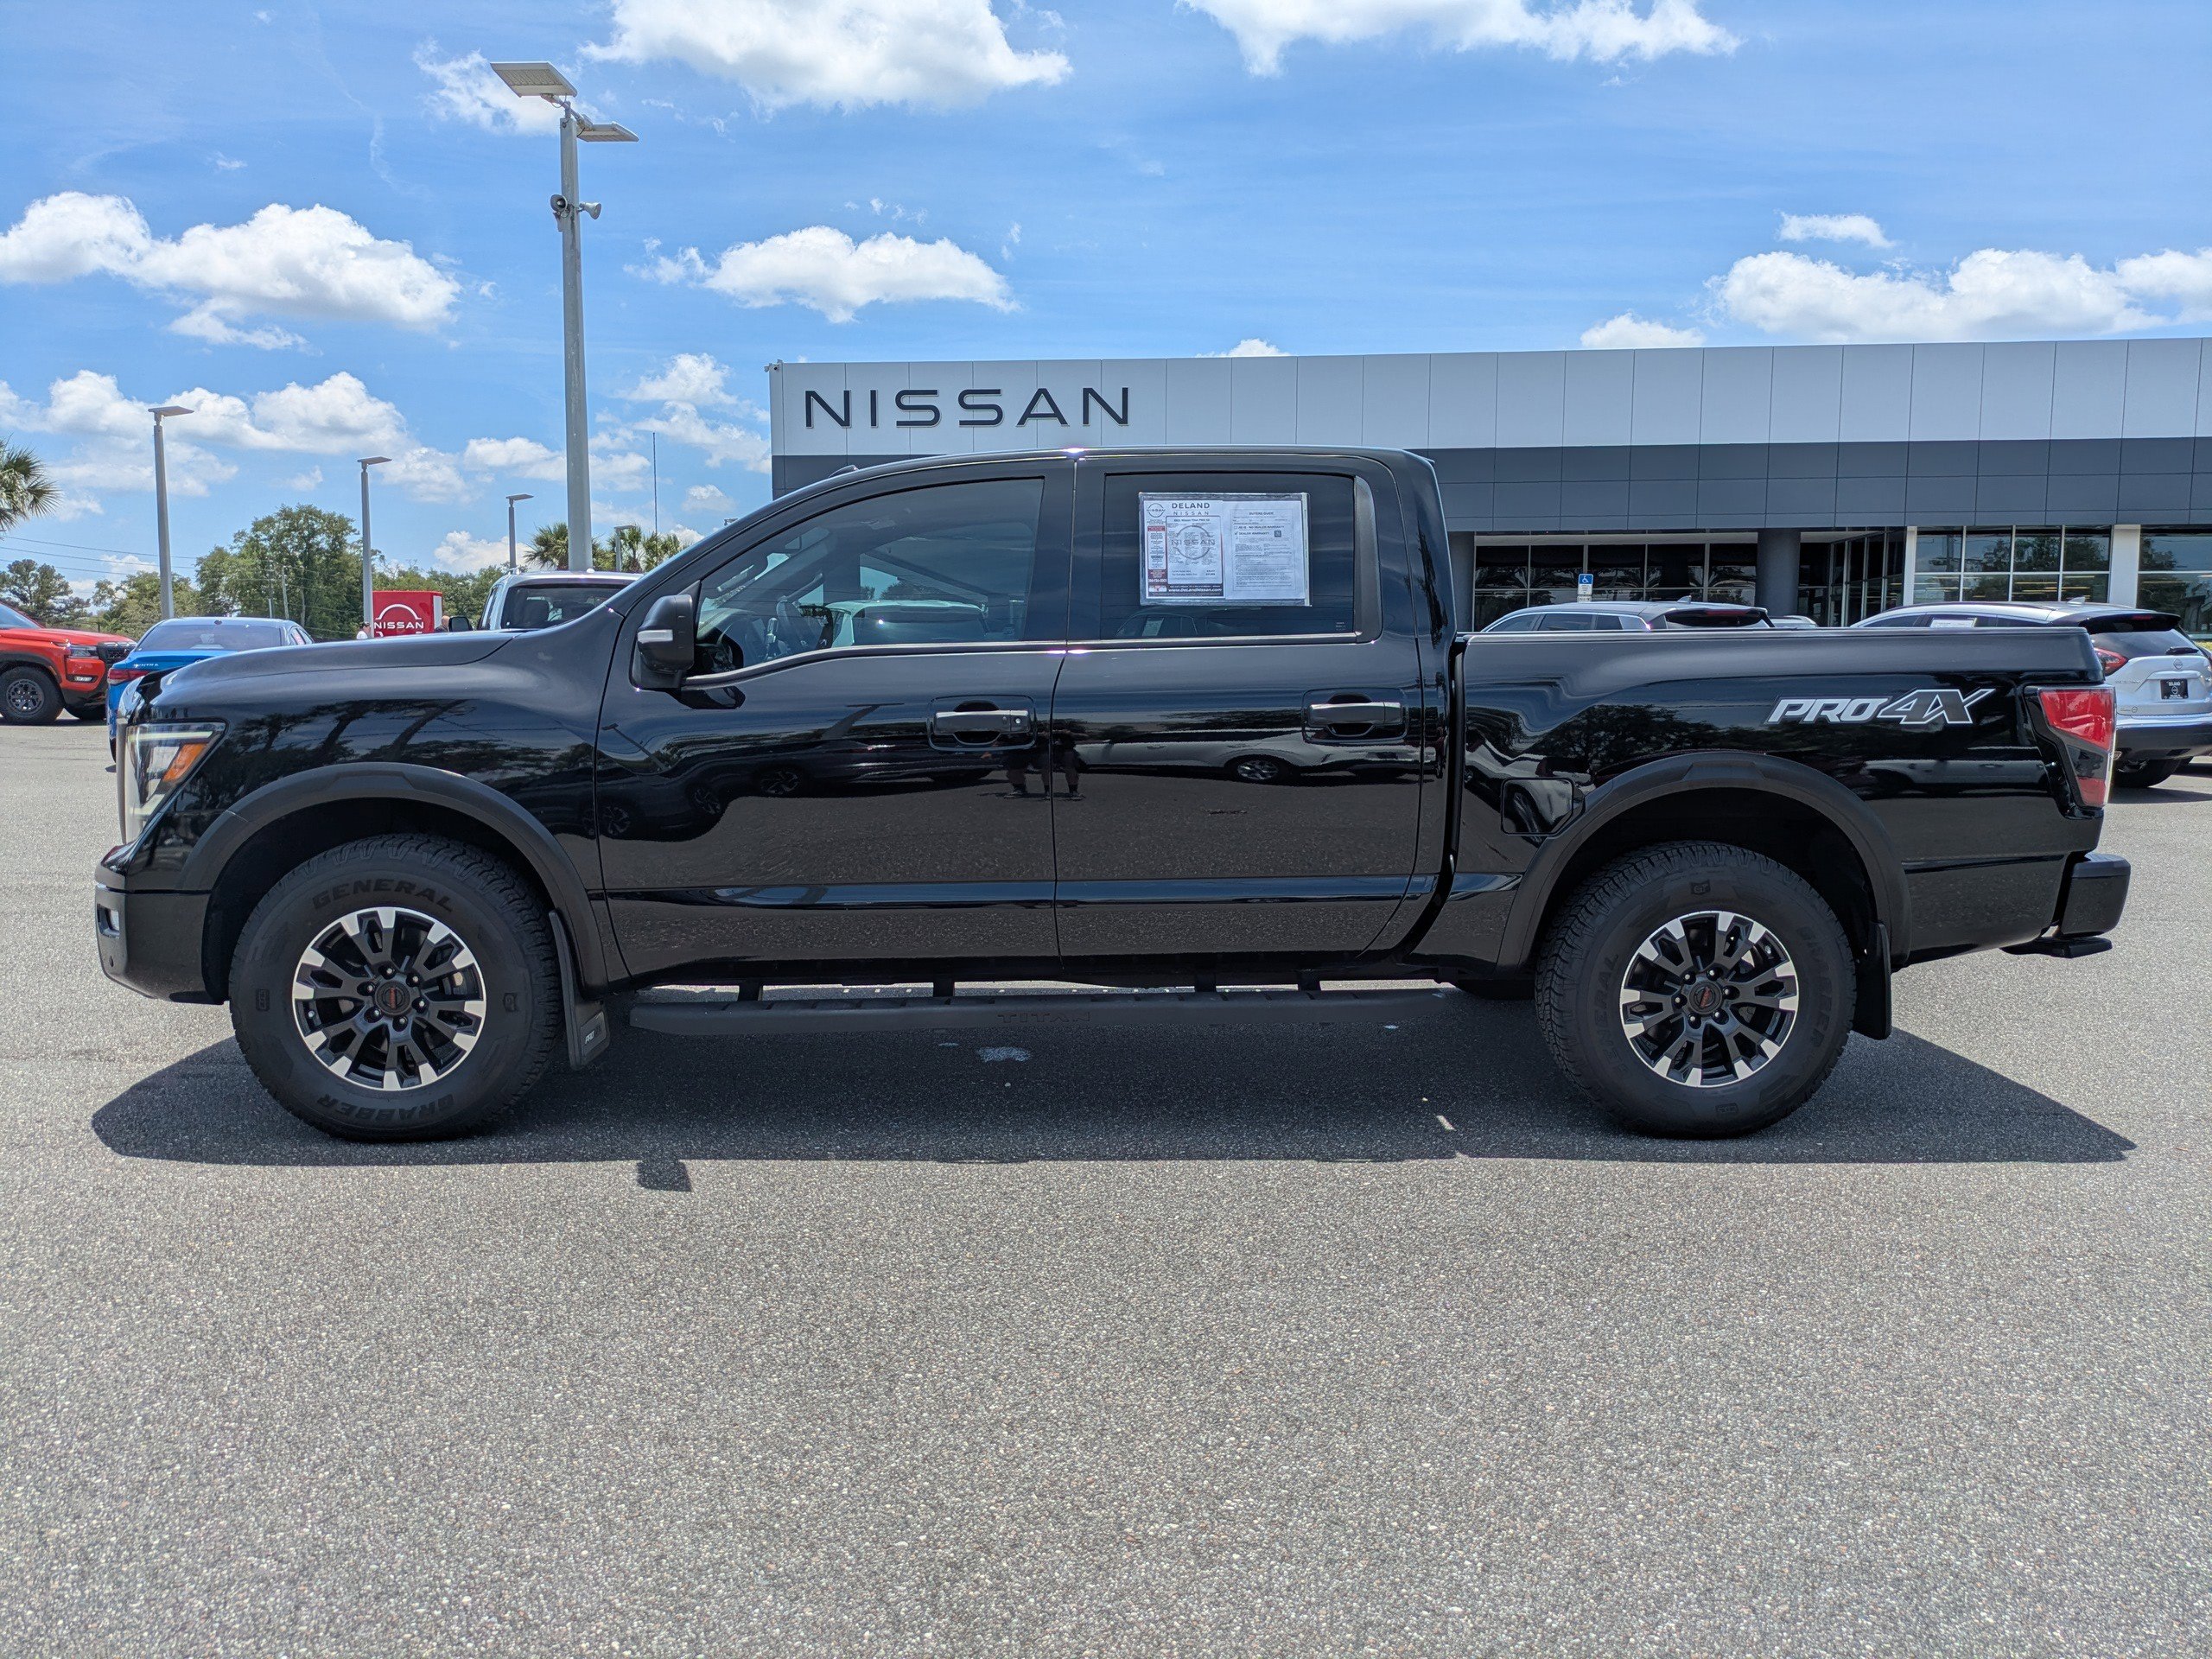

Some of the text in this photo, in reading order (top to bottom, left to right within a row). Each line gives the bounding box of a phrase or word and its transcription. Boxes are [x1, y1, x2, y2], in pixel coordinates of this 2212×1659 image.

[804, 387, 1129, 428] NISSAN
[313, 878, 454, 912] GENERAL
[997, 1012, 1090, 1023] TITAN
[315, 1093, 454, 1122] GRABBER
